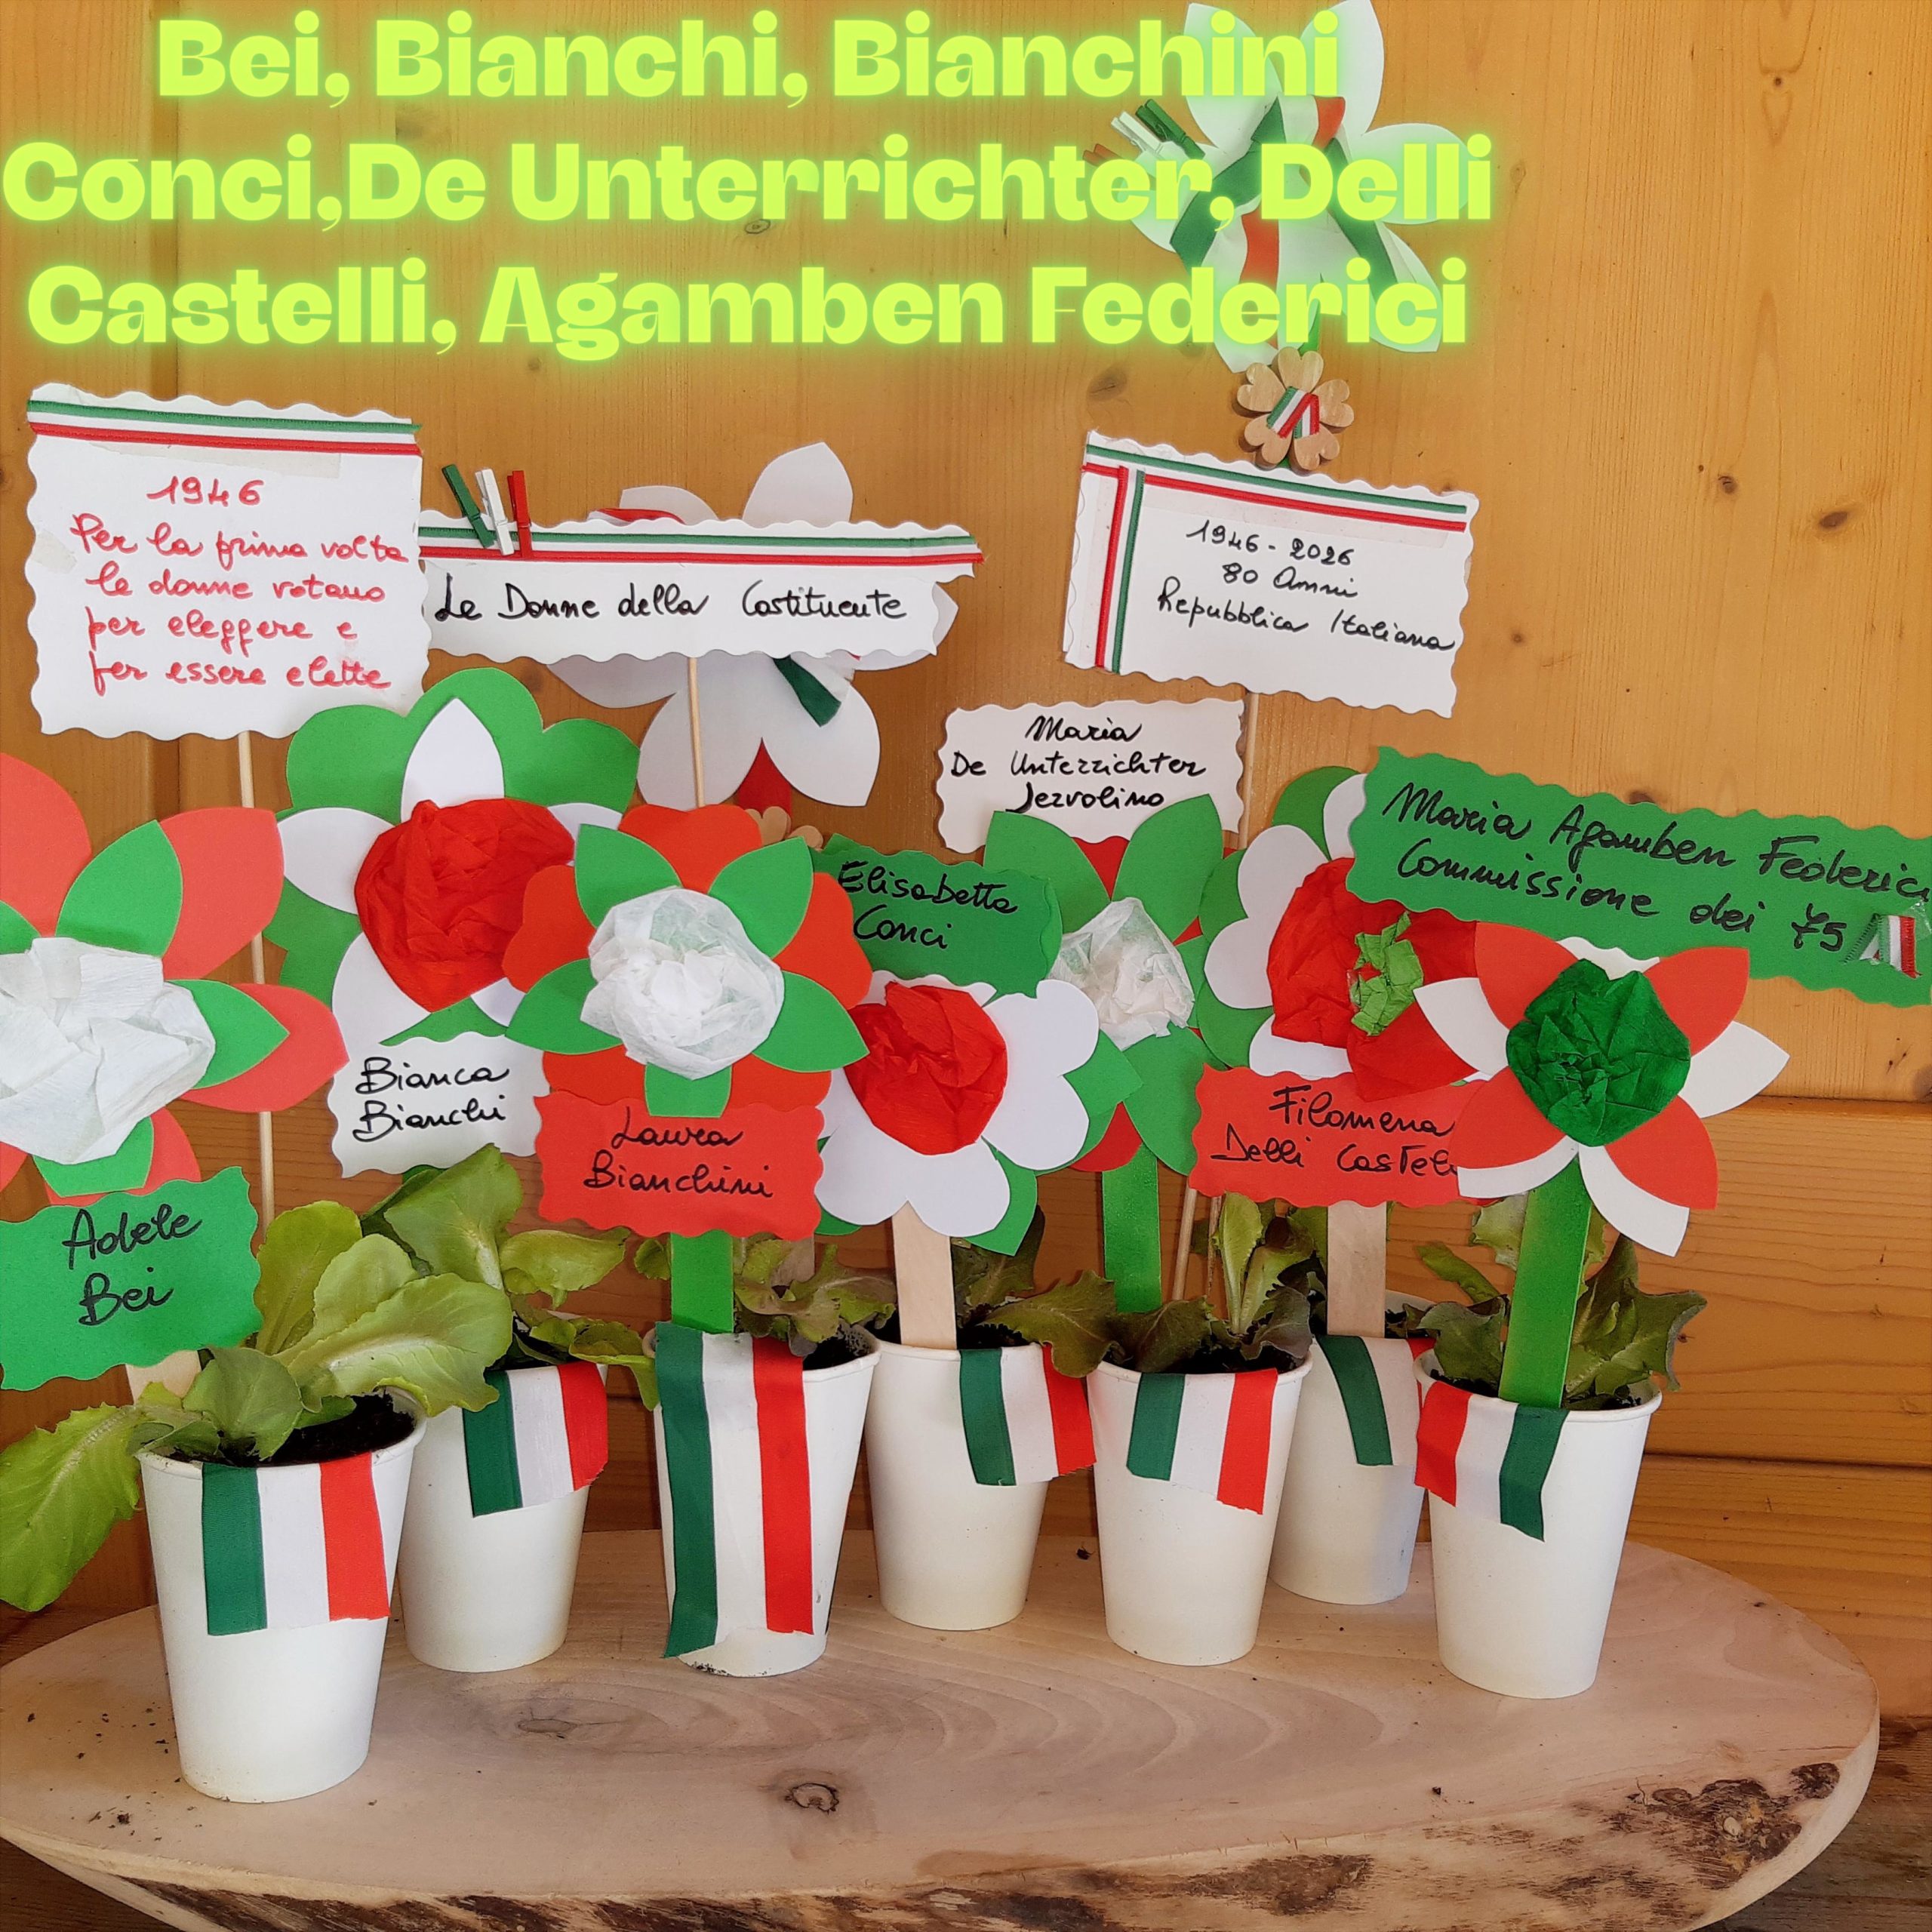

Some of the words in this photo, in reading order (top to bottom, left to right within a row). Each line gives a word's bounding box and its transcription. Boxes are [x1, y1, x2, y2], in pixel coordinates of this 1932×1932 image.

[149, 478, 262, 505] 1946
[71, 514, 136, 552] Per
[149, 523, 202, 555] la
[217, 533, 306, 570] prima
[323, 536, 407, 561] volta
[87, 561, 130, 595] le
[149, 566, 249, 598] donne
[273, 576, 384, 601] votano
[1223, 563, 1258, 583] 80
[435, 574, 481, 621] Le
[498, 583, 599, 619] Donne
[618, 583, 709, 616] della
[743, 581, 906, 618] Costituente
[1157, 577, 1310, 629] Repubblica
[1331, 610, 1454, 650] Italiana
[87, 608, 144, 649] per
[169, 610, 309, 655] eleggere
[337, 621, 358, 640] e
[90, 652, 146, 695] per
[167, 663, 264, 684] essere
[287, 657, 389, 688] elette
[1026, 715, 1142, 742] Maria
[951, 751, 986, 777] De
[1382, 783, 1531, 841] Maria
[1549, 801, 1736, 872] Agamben
[837, 861, 1017, 915] Elisabetta
[1397, 838, 1661, 918] Commissione
[1690, 893, 1765, 932] dei
[1792, 903, 1847, 952] 75
[853, 904, 953, 950] Conci
[355, 1057, 509, 1094] Bianca
[352, 1094, 506, 1141] Bianchi
[611, 1106, 743, 1148] Laura
[1269, 1084, 1456, 1137] Filomena
[1210, 1123, 1313, 1168] Delli
[583, 1149, 774, 1198] Bianchini
[62, 1204, 202, 1271] Adele
[78, 1267, 174, 1325] Bei
